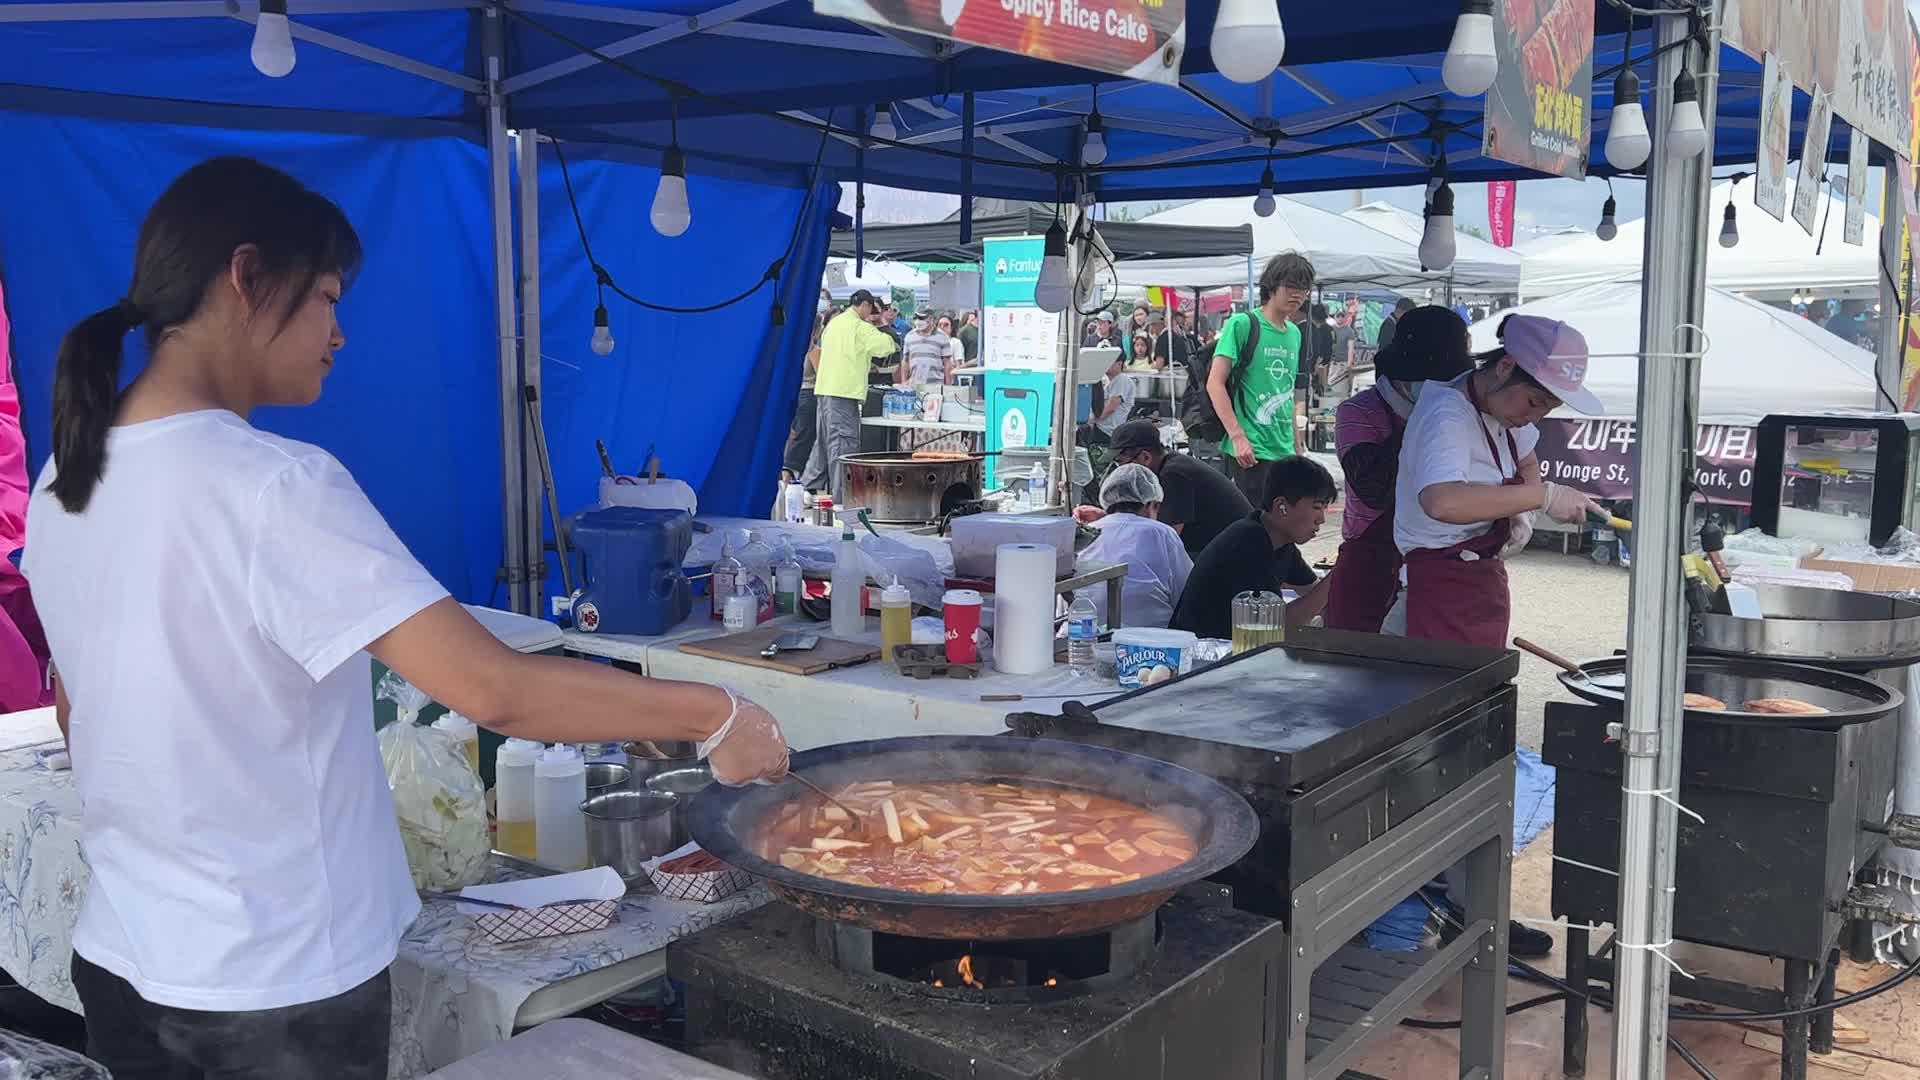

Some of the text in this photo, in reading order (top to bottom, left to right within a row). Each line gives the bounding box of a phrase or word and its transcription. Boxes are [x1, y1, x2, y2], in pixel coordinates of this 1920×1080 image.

[1060, 0, 1101, 31] Rice
[1105, 8, 1148, 43] Cake
[1555, 460, 1601, 483] Yonge
[1606, 463, 1631, 485] St,
[1122, 650, 1166, 672] PARLOUR
